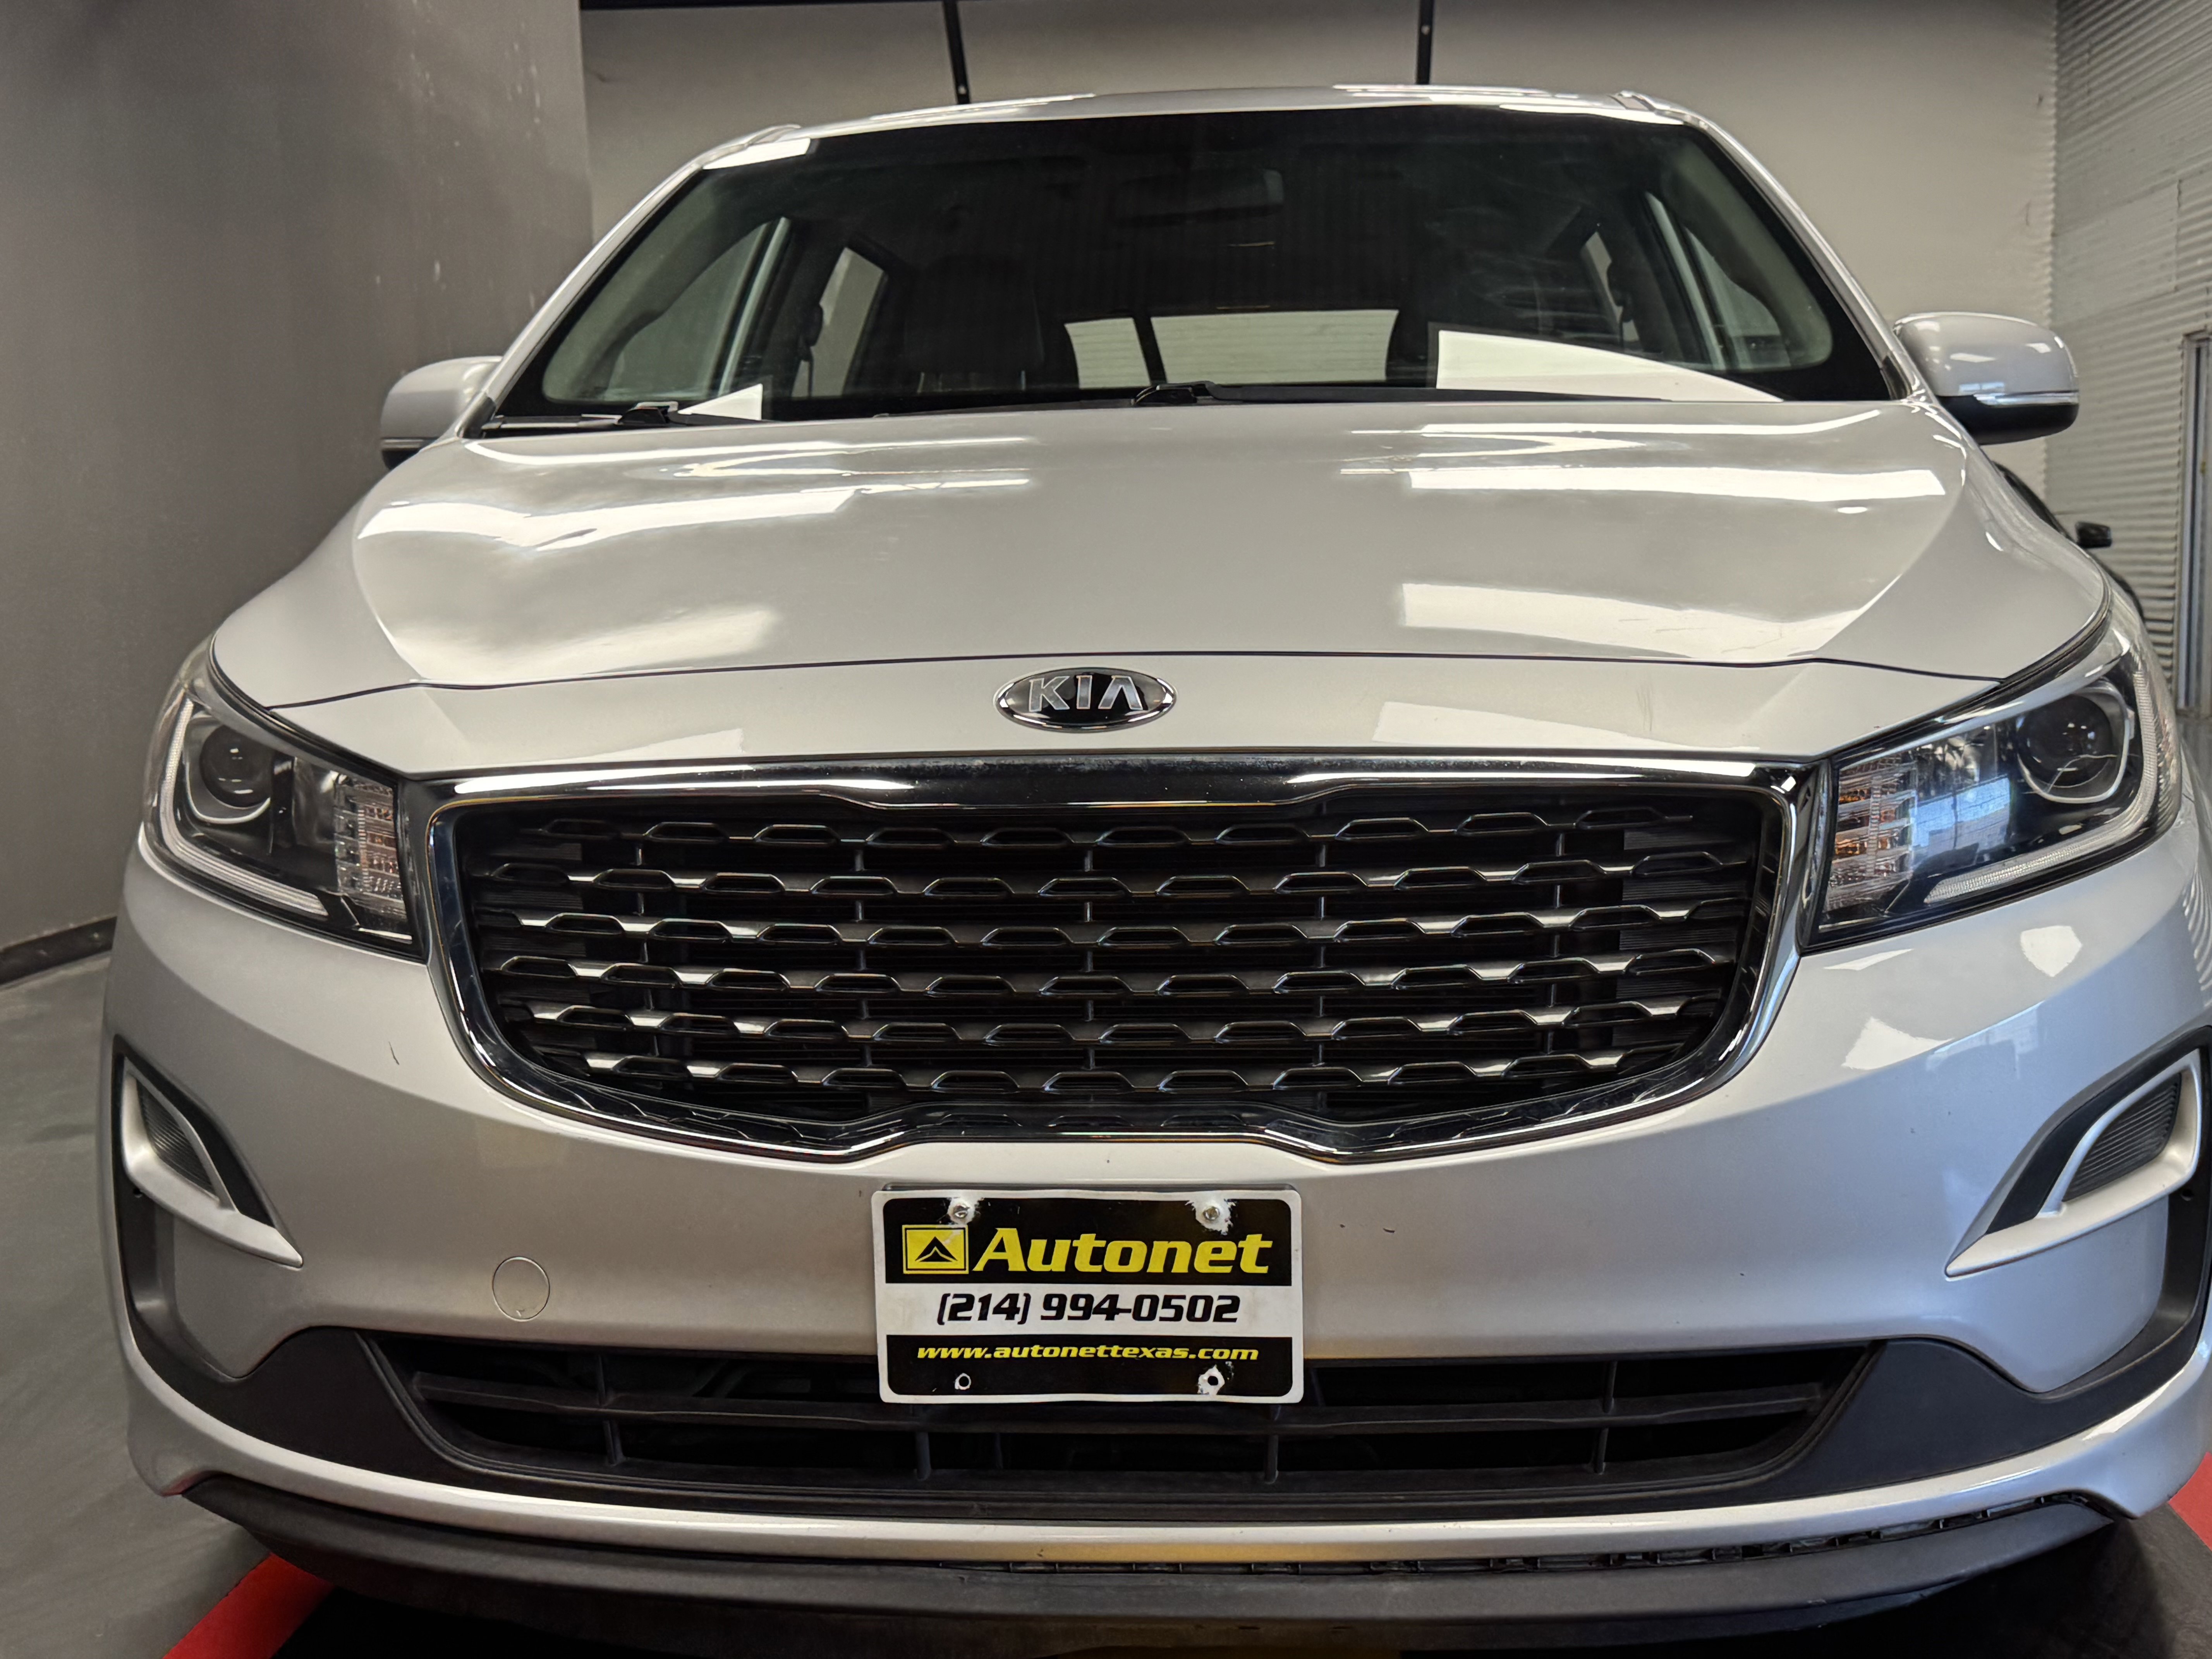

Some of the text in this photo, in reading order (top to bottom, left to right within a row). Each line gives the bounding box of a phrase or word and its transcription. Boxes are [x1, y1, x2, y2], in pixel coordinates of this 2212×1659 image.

[1029, 675, 1143, 712] KIA
[972, 1228, 1273, 1274] Autonet
[937, 1293, 1240, 1325] (214) 994-0502
[917, 1345, 1259, 1360] www.autonettexas.com
